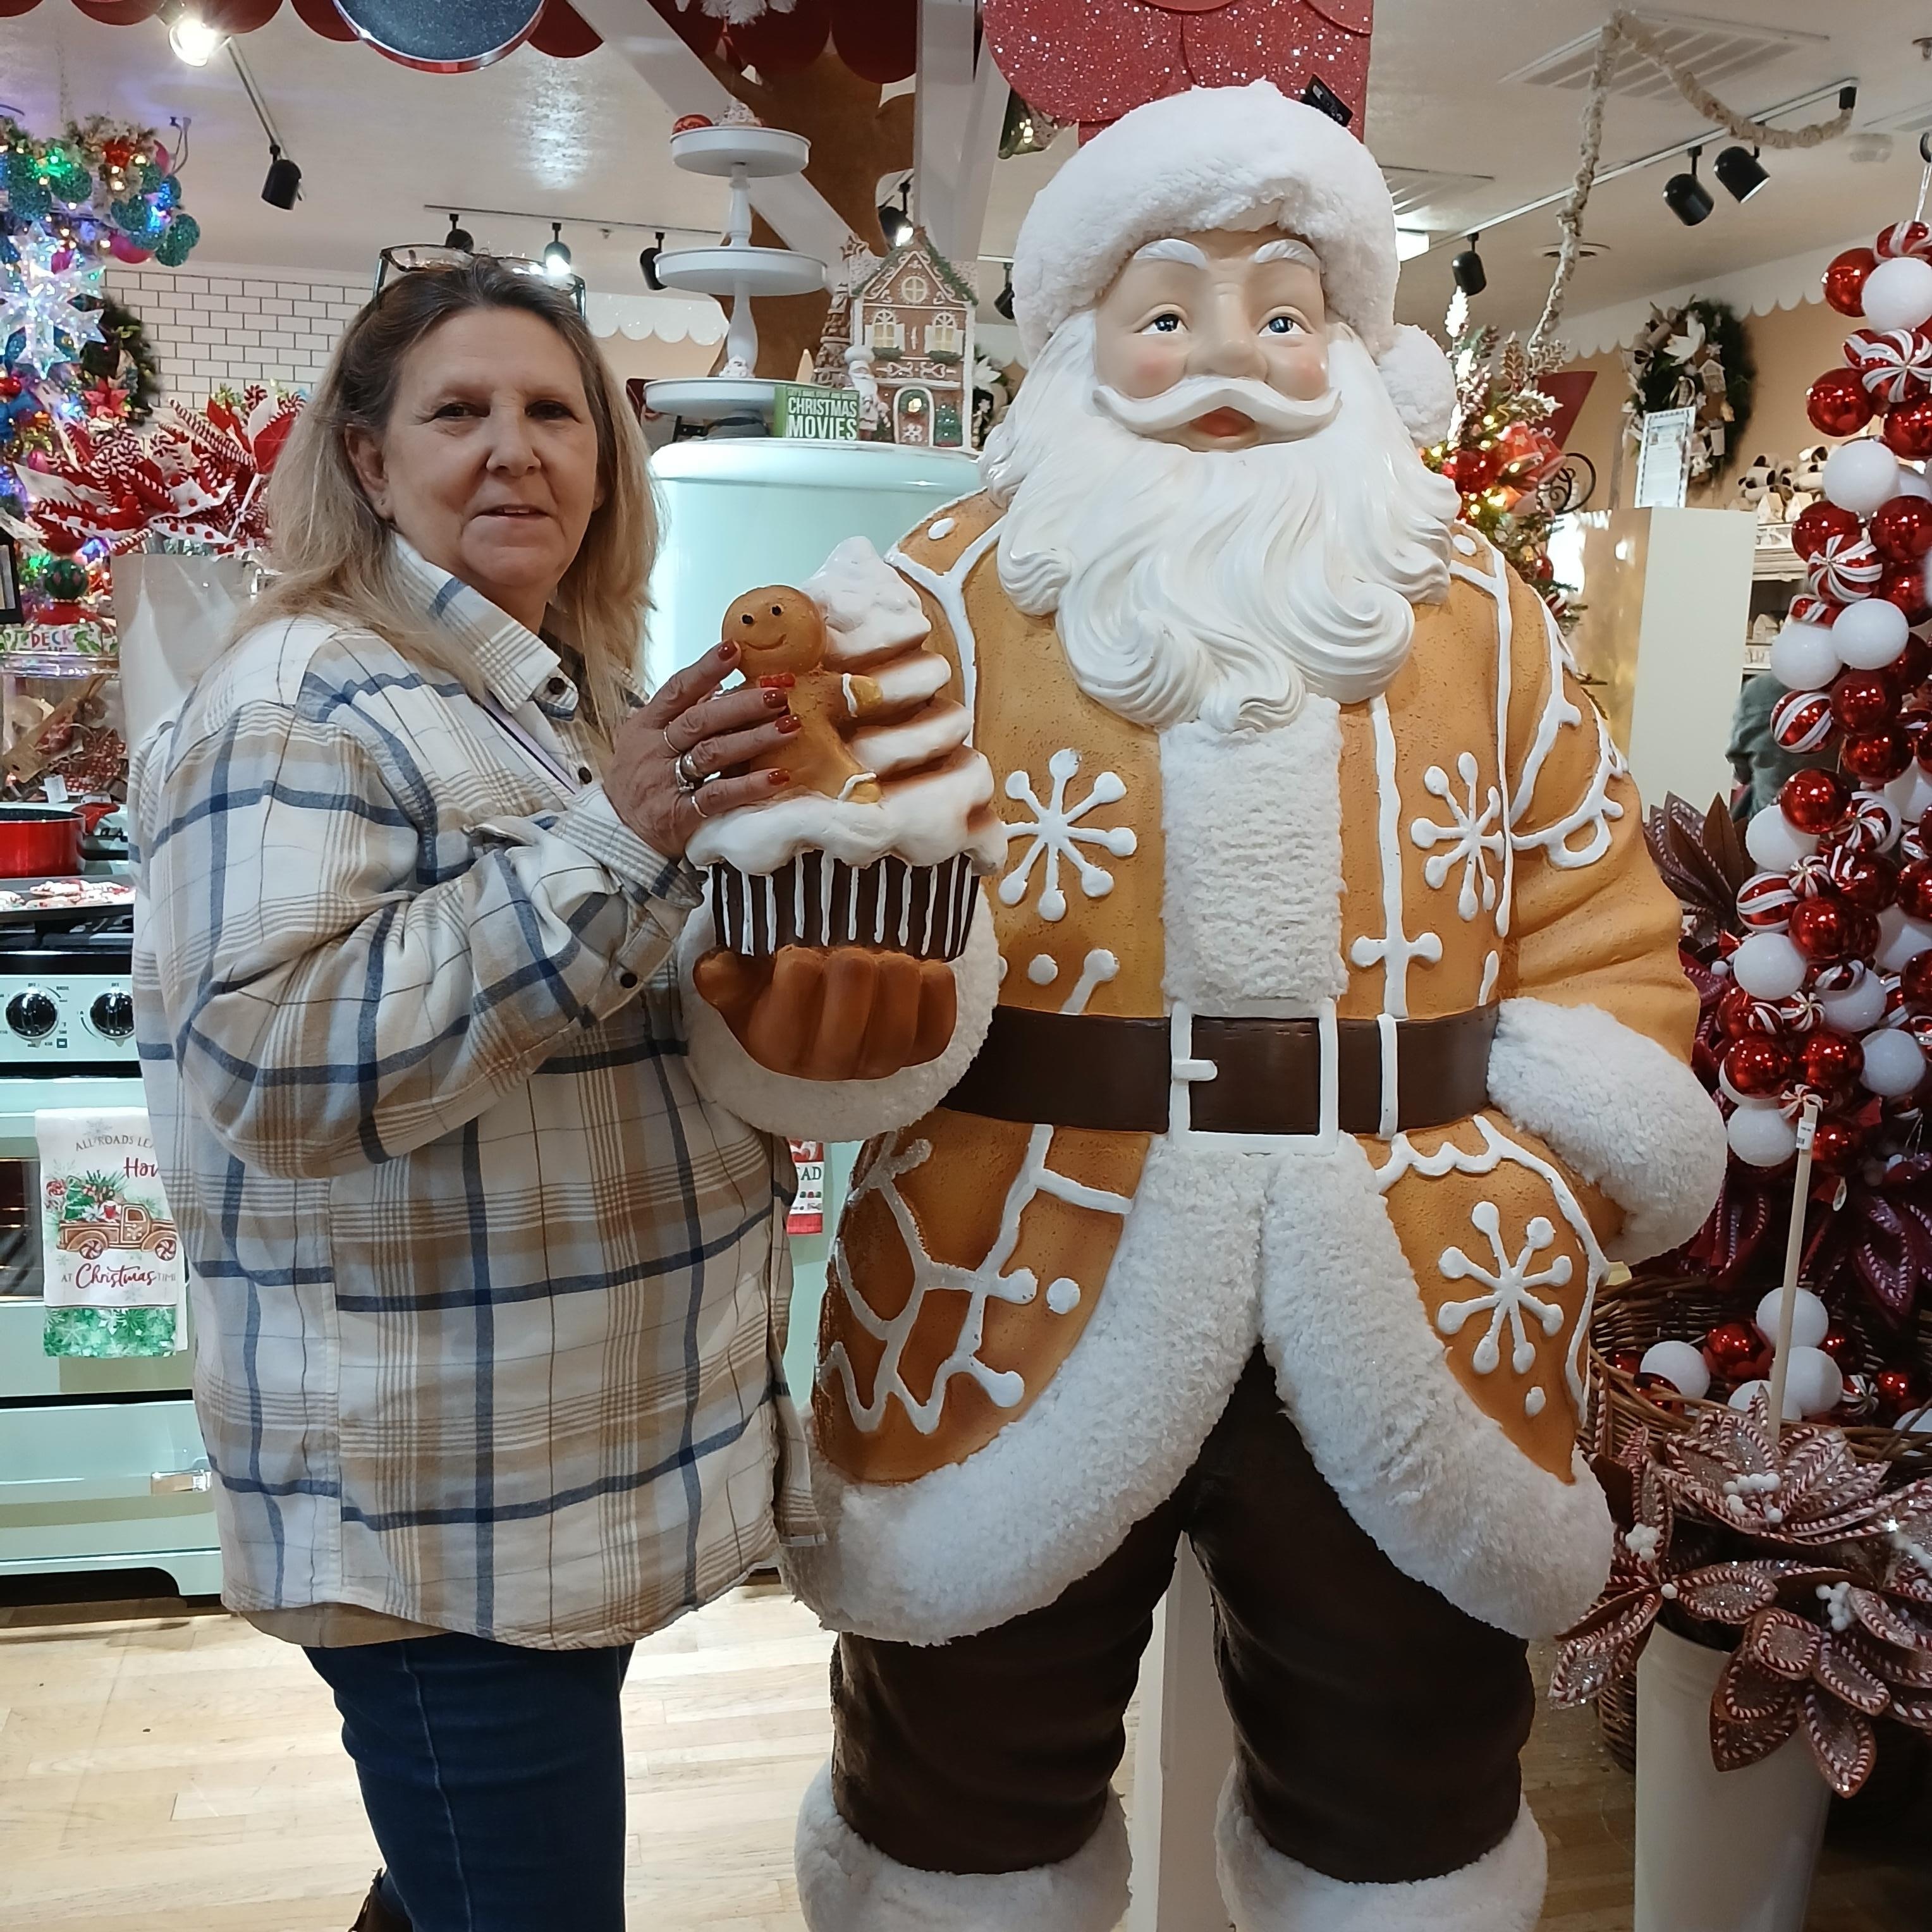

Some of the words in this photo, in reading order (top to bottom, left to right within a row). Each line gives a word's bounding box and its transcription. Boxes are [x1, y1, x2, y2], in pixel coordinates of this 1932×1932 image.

[788, 397, 857, 417] CHRISTMAS
[787, 415, 857, 441] MOVIES
[32, 630, 73, 648] DECK
[76, 1139, 96, 1151] ALL
[98, 1135, 133, 1146] ROADS
[796, 1166, 821, 1181] AD
[61, 1273, 73, 1283] AT
[75, 1263, 157, 1289] Christmas
